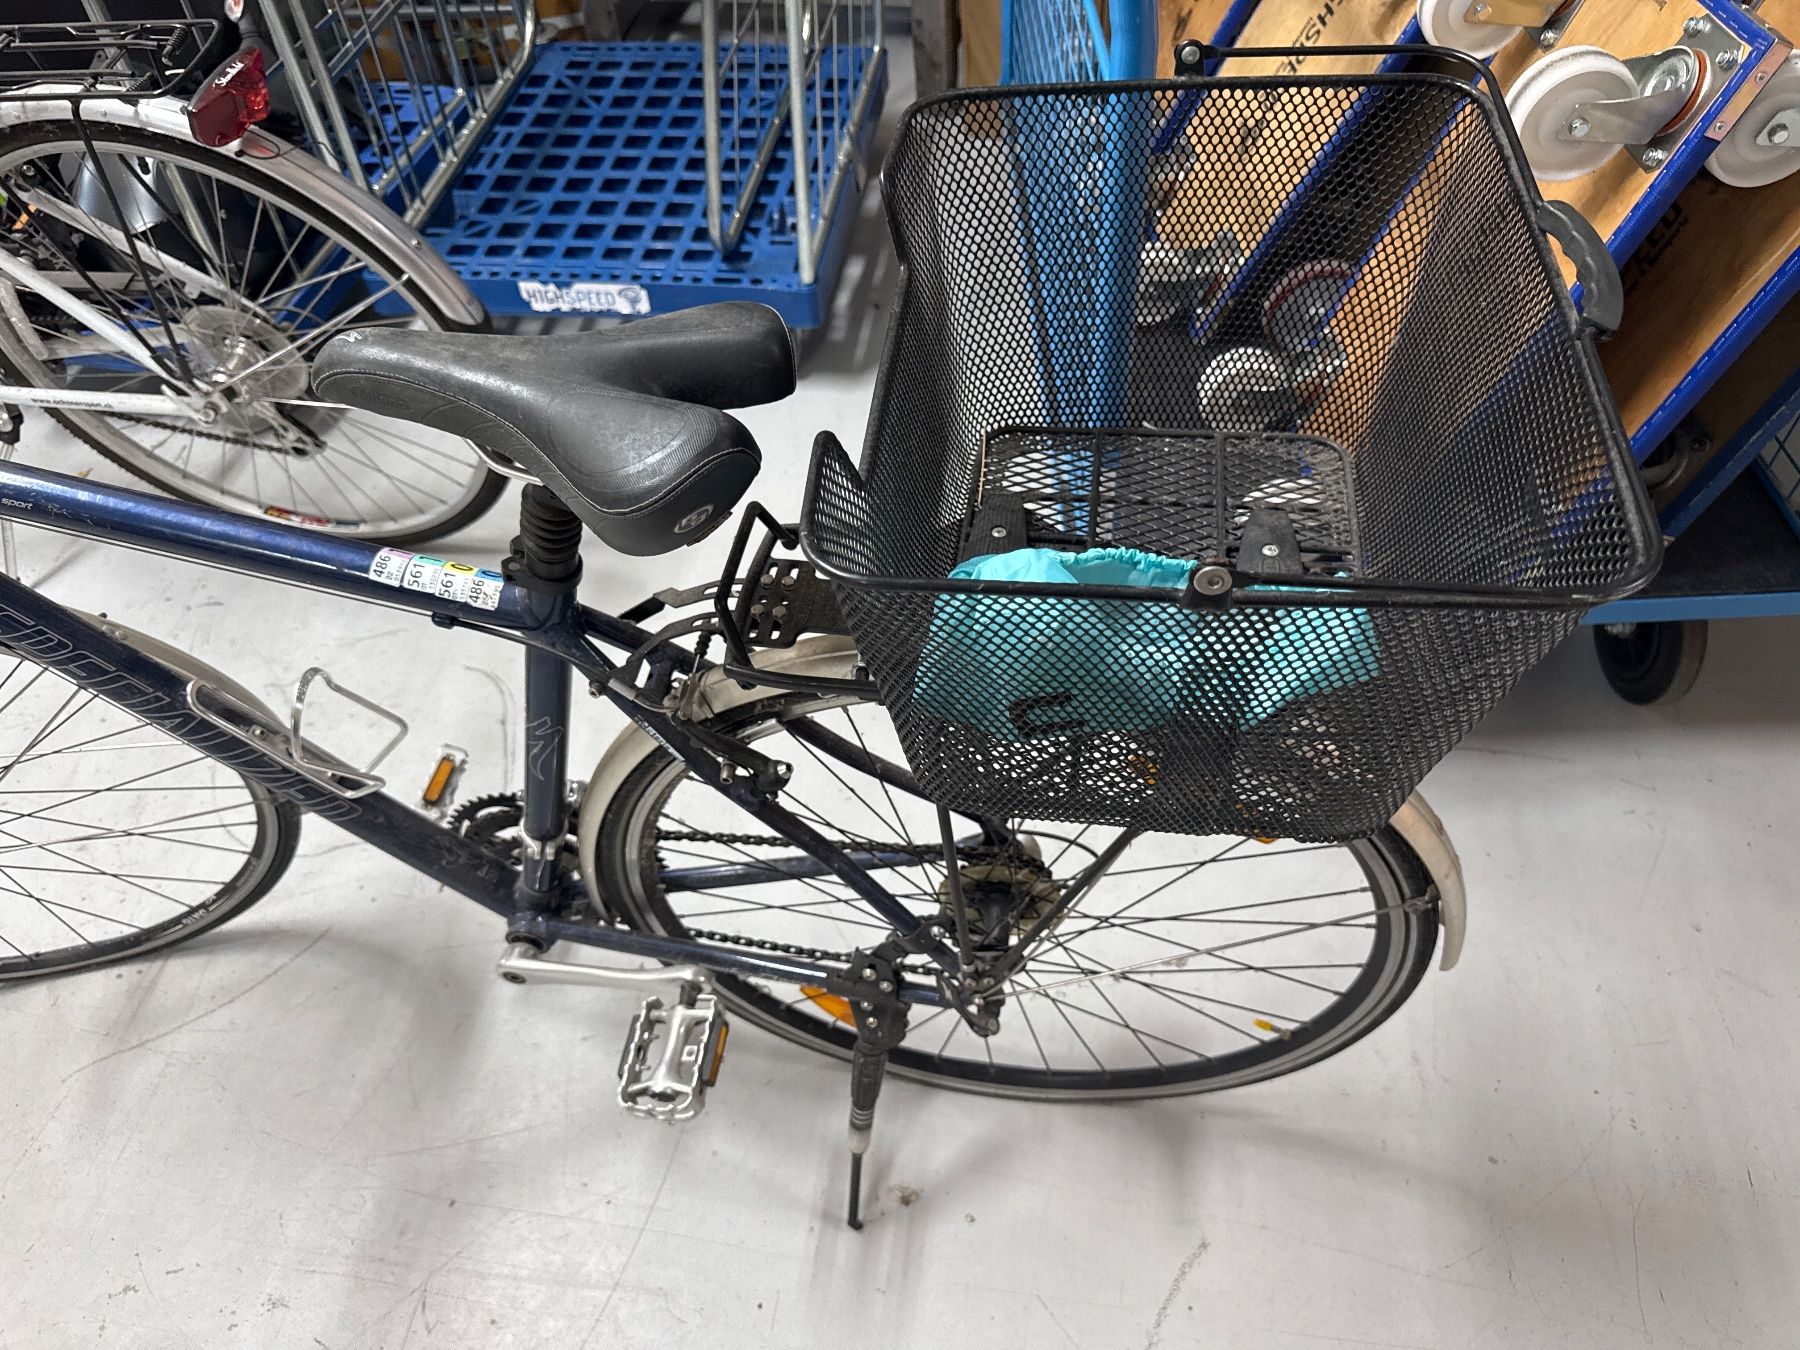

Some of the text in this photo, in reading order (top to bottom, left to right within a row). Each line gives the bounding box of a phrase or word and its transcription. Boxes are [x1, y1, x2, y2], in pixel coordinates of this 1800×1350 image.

[525, 287, 617, 307] HIGHSPEED
[1, 497, 33, 510] sport
[373, 555, 392, 578] 486
[407, 563, 426, 589] 561
[438, 572, 457, 598] 561
[468, 579, 485, 604] 486
